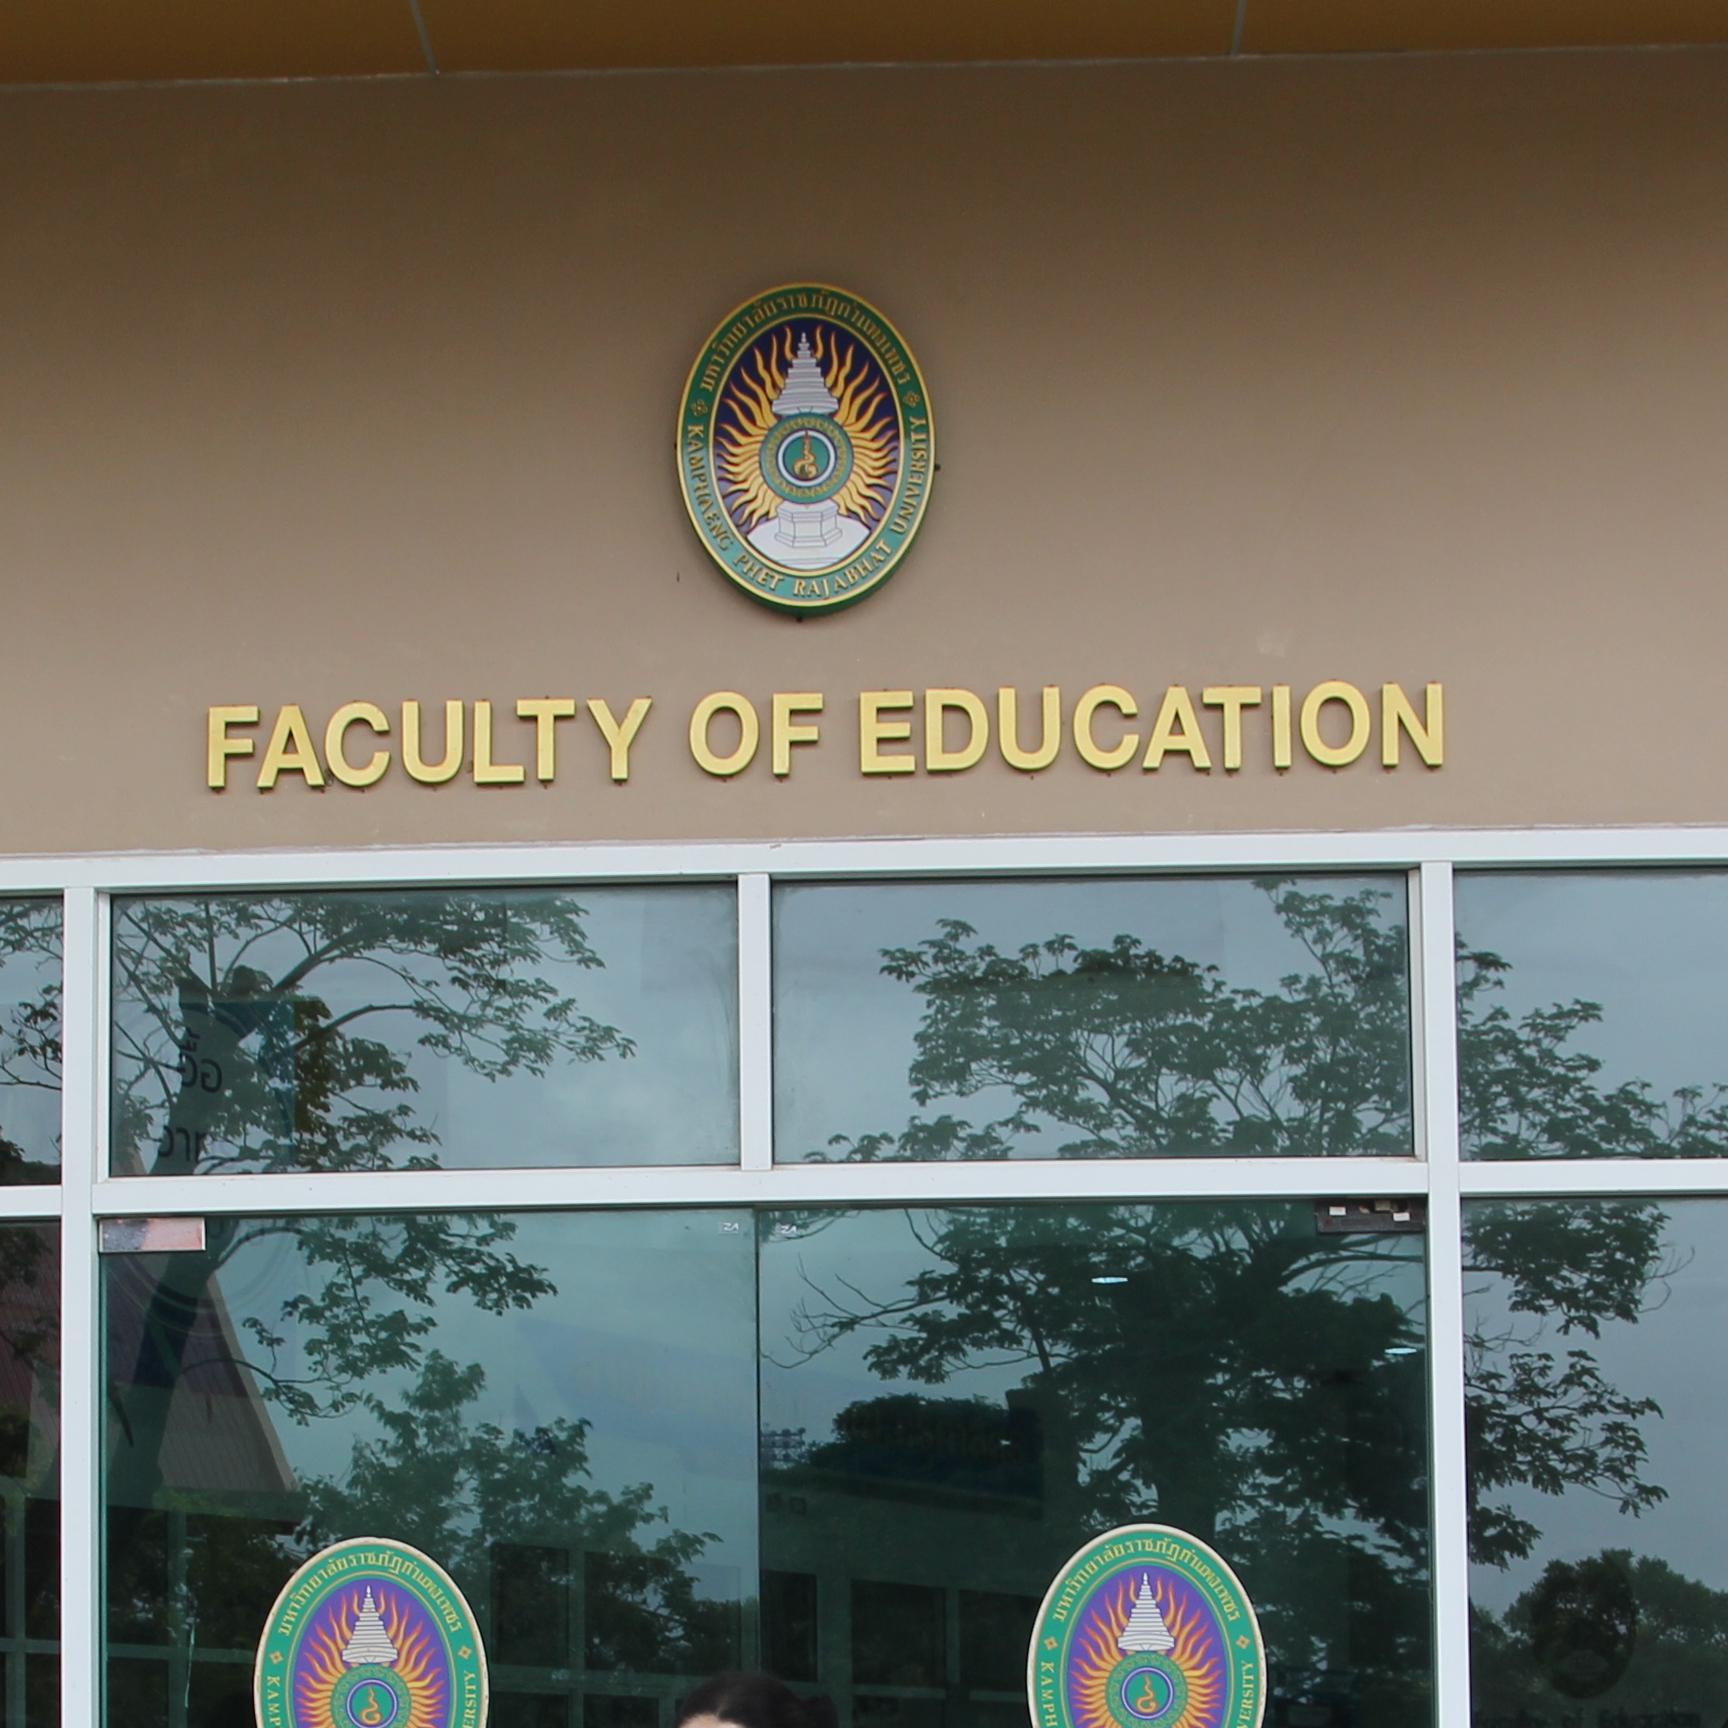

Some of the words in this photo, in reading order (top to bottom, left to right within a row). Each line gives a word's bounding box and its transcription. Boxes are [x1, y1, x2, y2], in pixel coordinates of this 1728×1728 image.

[687, 424, 736, 552] KAMPHAENG
[734, 553, 785, 591] PHET
[793, 538, 894, 600] RAJABHAT
[889, 416, 929, 536] UNIVERSITY
[206, 697, 653, 791] FACULTY
[689, 689, 825, 780] OF
[860, 681, 1447, 777] EDUCATION
